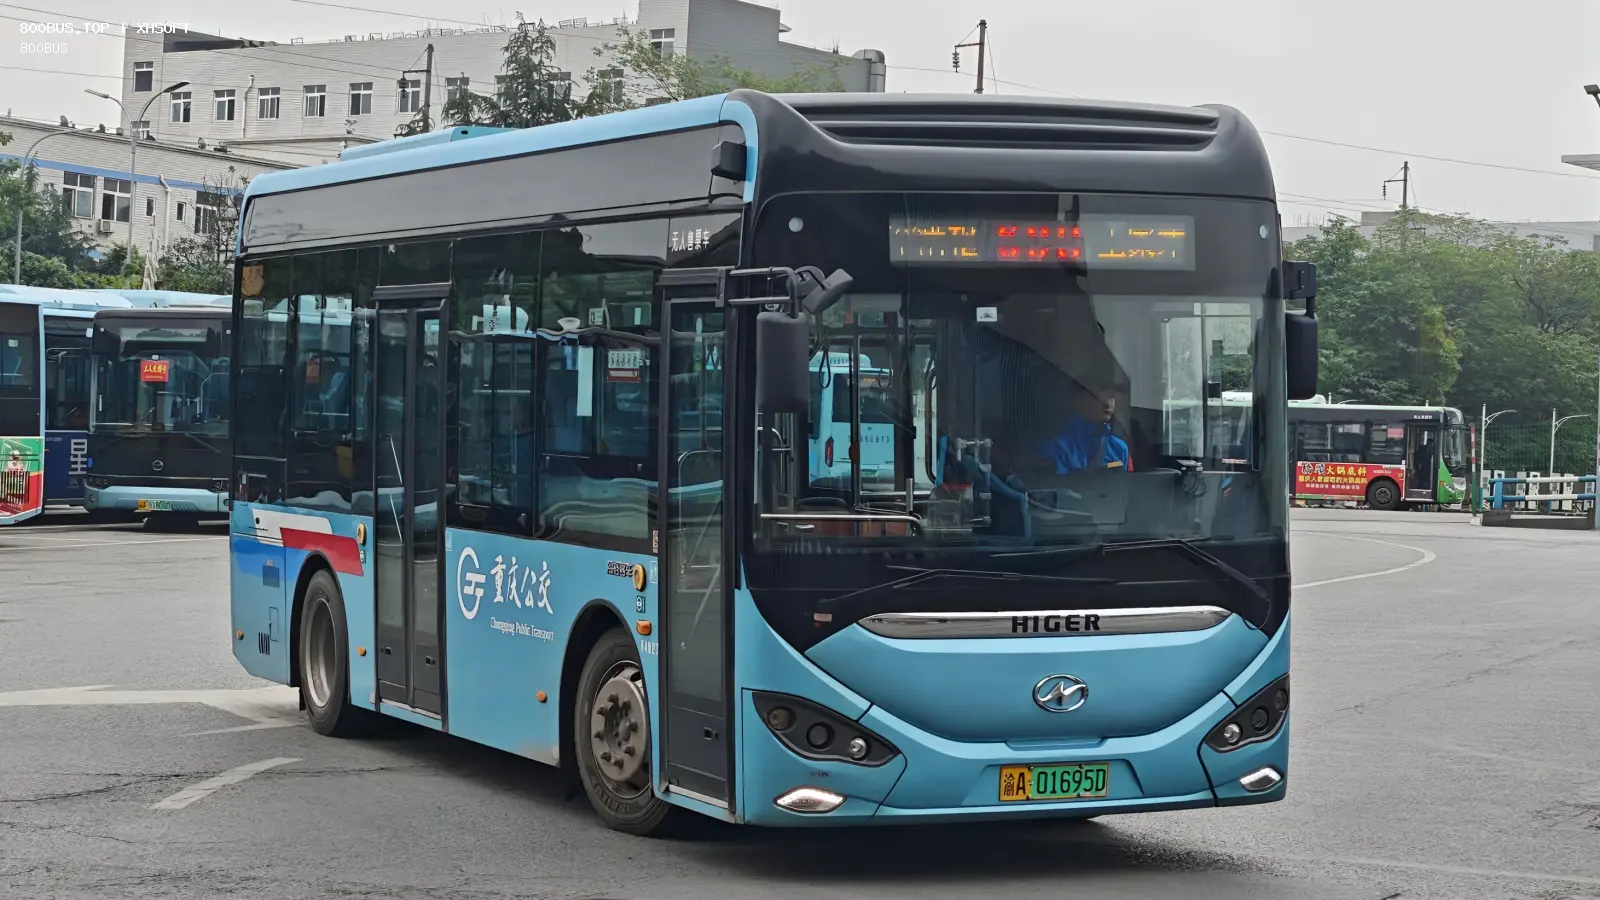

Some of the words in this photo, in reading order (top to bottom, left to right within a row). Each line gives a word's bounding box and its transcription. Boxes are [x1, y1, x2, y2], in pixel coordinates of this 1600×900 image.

[490, 555, 553, 615] 重庆公交
[515, 621, 531, 636] Public
[1011, 613, 1101, 633] HIGER
[1036, 768, 1107, 795] 01695D
